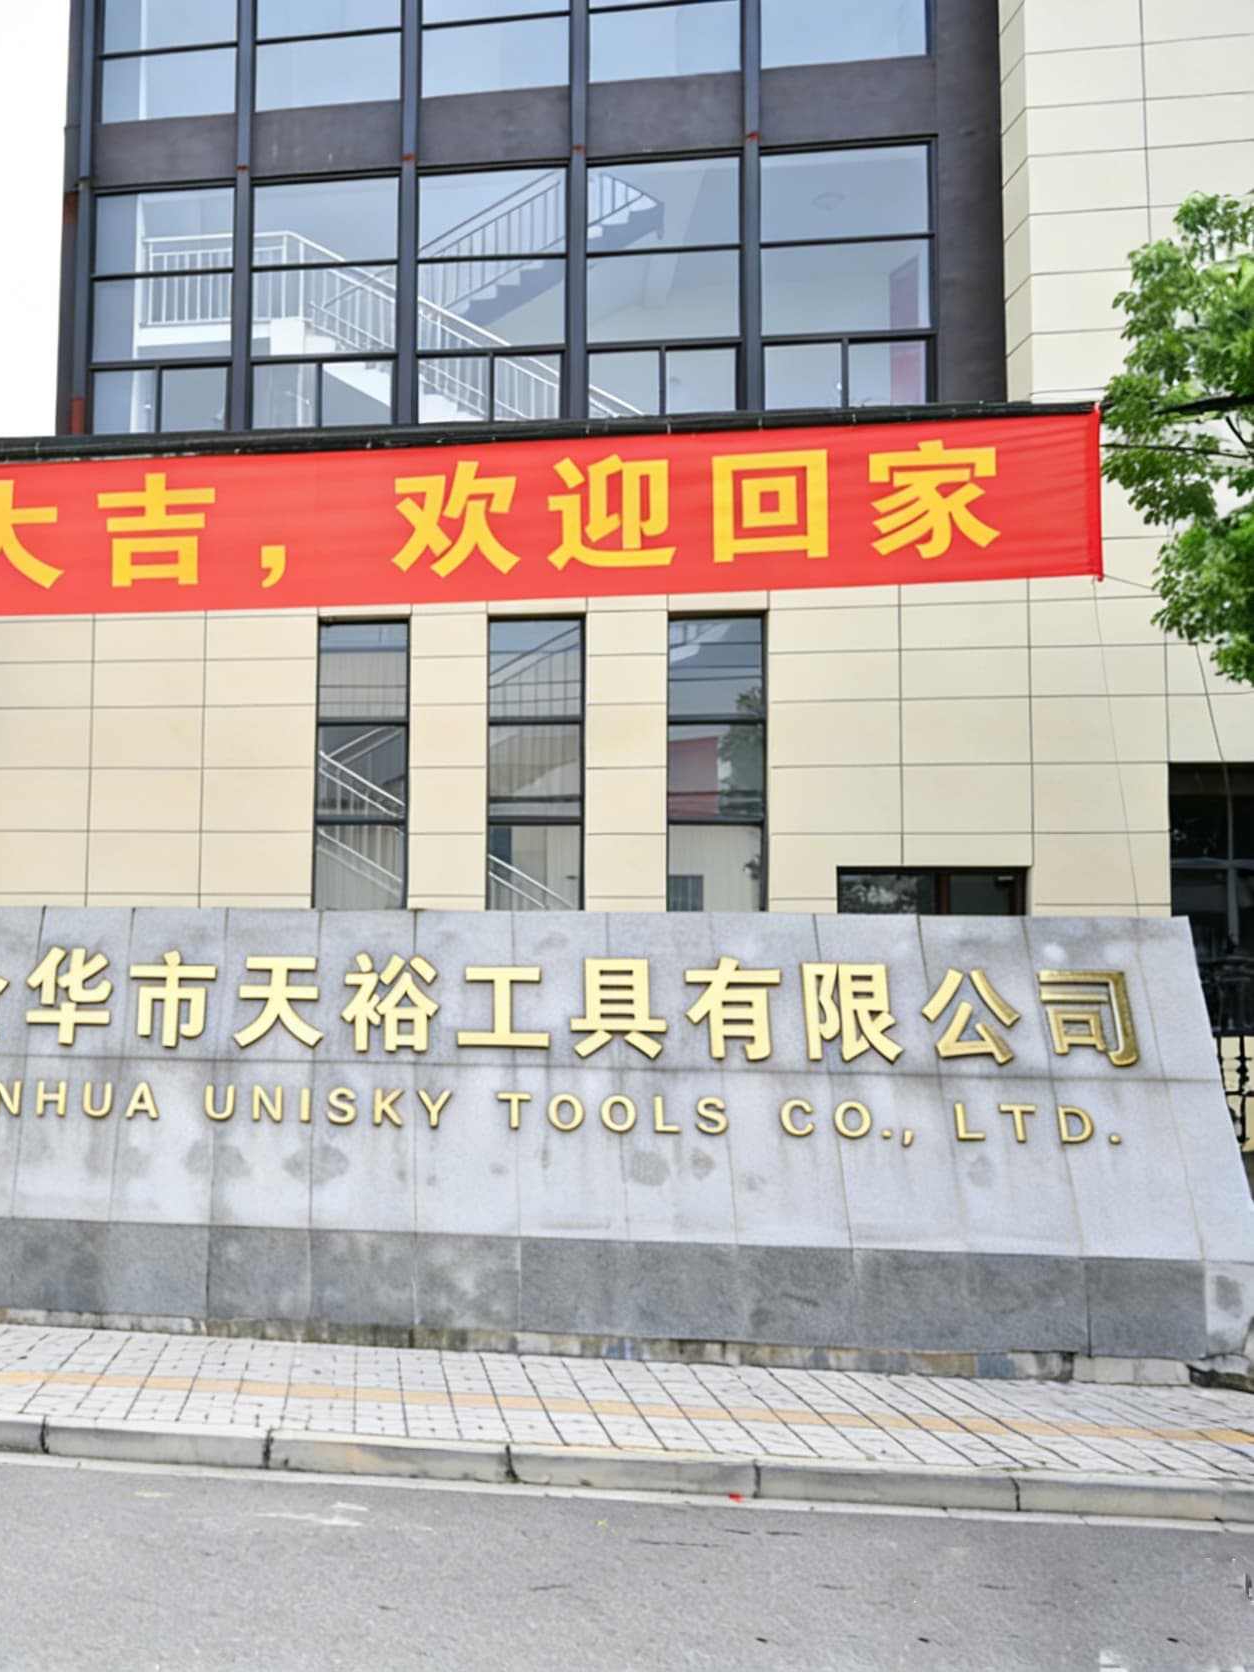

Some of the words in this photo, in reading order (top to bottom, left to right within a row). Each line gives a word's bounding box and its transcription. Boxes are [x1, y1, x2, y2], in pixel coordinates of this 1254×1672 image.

[203, 1083, 454, 1130] UNISKY
[496, 1091, 730, 1136] TOOLS
[779, 1099, 916, 1148] CO.,
[953, 1102, 1123, 1146] LTD.
